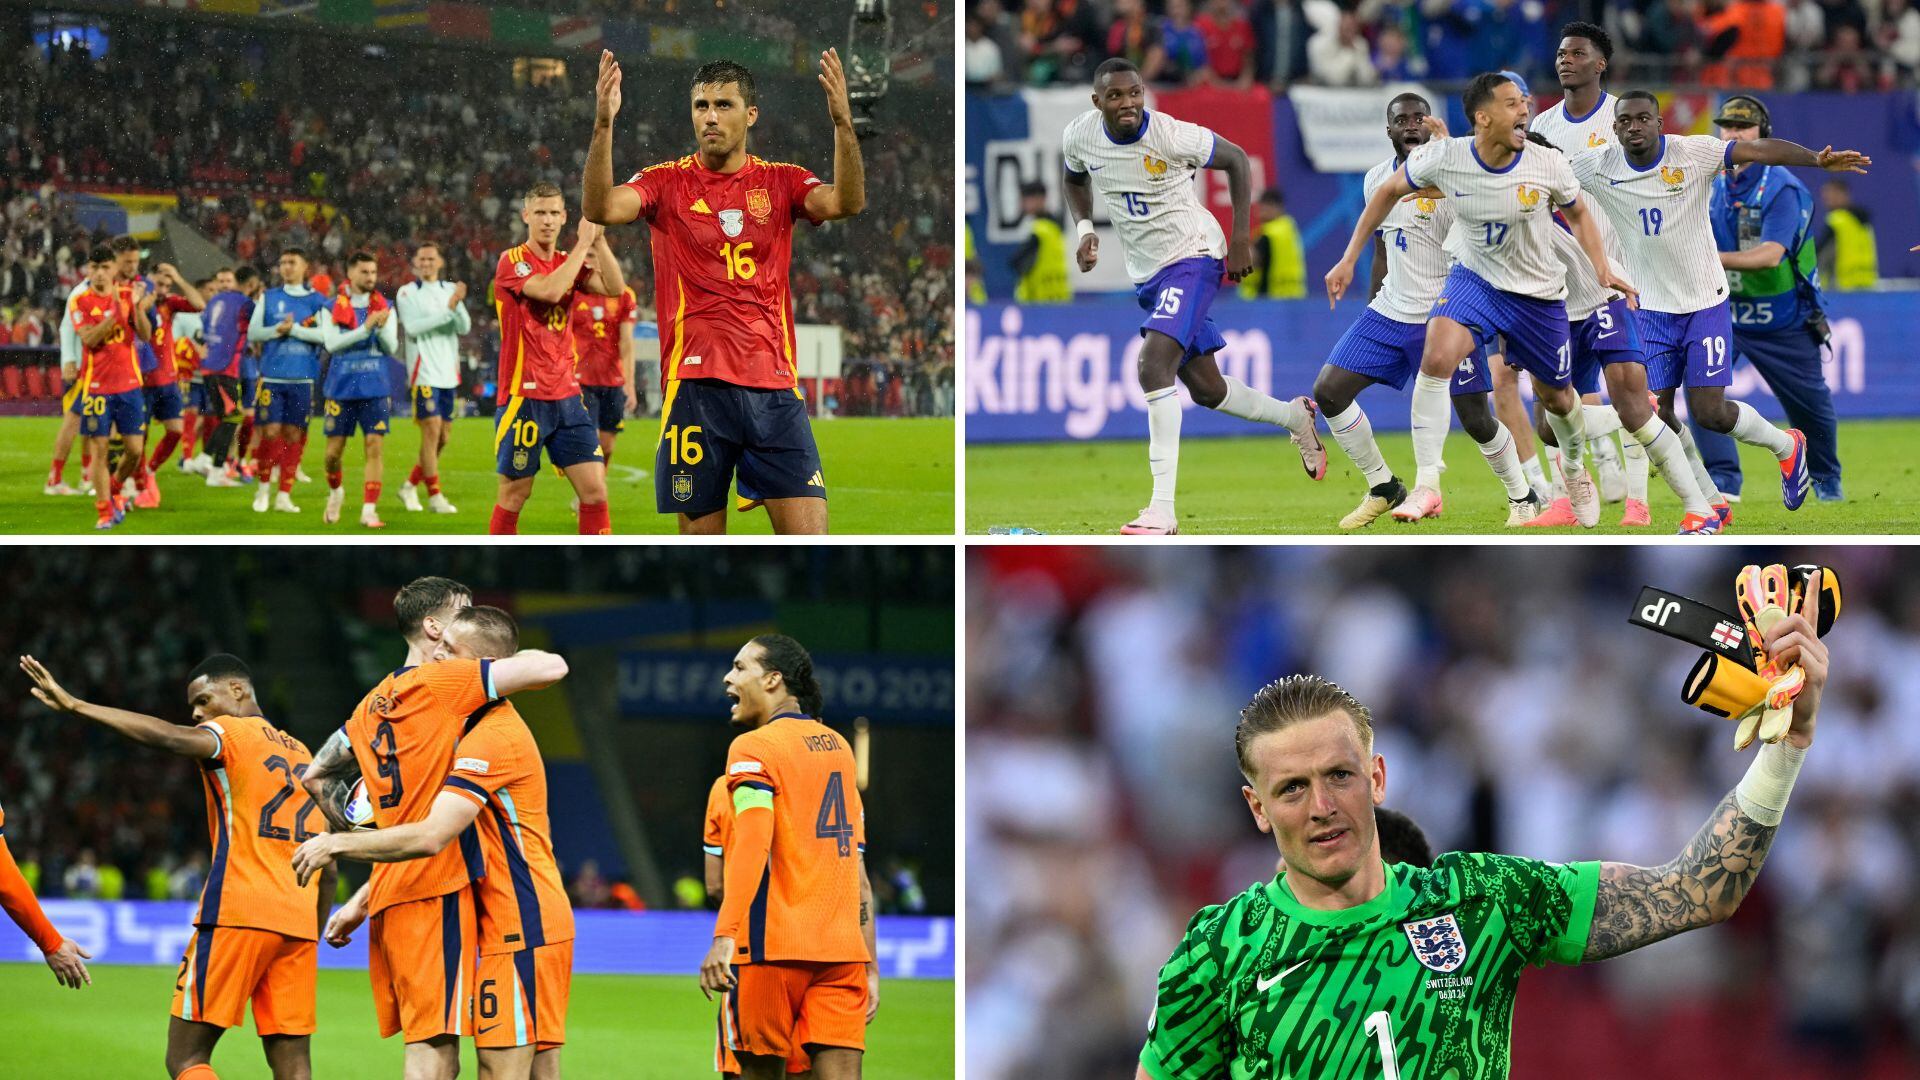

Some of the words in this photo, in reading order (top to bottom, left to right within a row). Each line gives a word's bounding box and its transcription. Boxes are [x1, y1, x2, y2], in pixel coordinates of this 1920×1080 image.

[1121, 191, 1151, 217] 15
[1483, 222, 1509, 246] 17
[1638, 207, 1664, 237] 19
[1395, 227, 1408, 252] 4
[719, 241, 757, 280] 16
[1156, 286, 1184, 315] 15
[1596, 305, 1614, 330] 5
[105, 324, 125, 345] 0
[1702, 335, 1726, 367] 19
[965, 306, 1272, 438] king.cm
[83, 395, 106, 416] 20
[512, 418, 539, 448] 10
[665, 424, 704, 466] 16
[1641, 597, 1681, 627] JP
[802, 733, 842, 752] VIRGIL
[370, 720, 404, 810] 9
[258, 754, 319, 843] 22
[815, 771, 854, 857] 4
[1425, 976, 1473, 989] SWITZERLAND
[479, 979, 498, 1019] 6
[1363, 1010, 1401, 1080] 1
